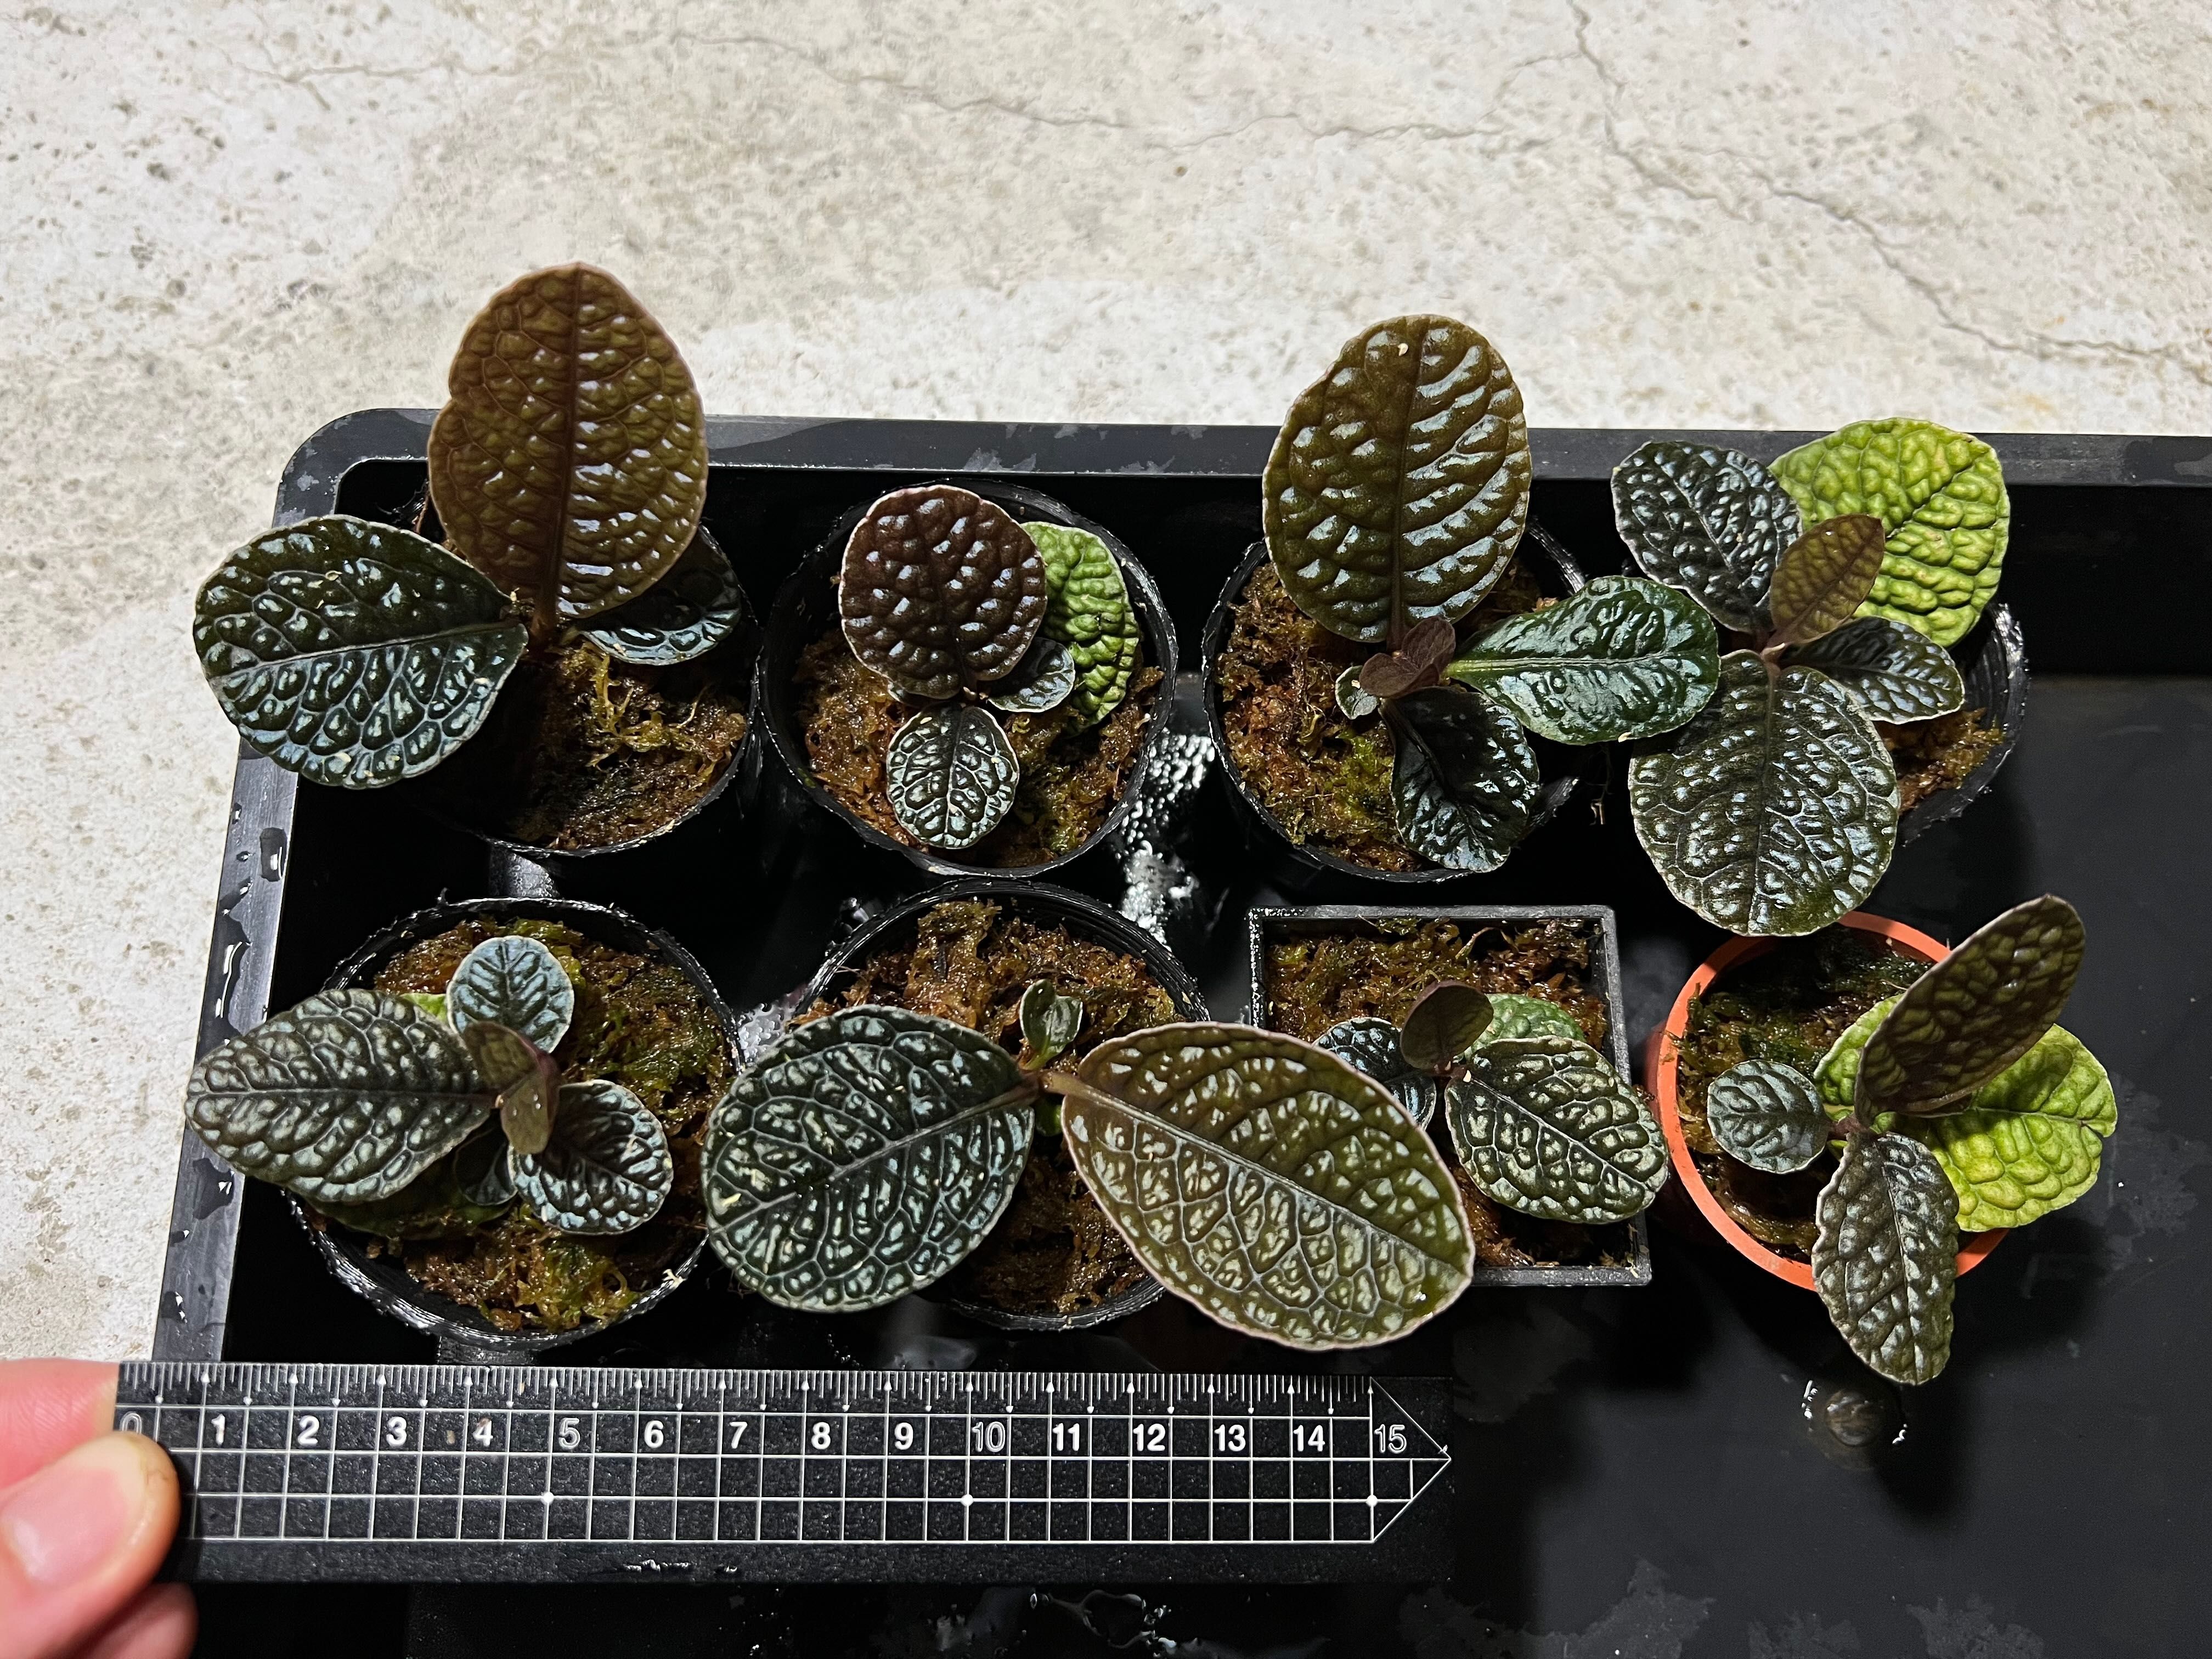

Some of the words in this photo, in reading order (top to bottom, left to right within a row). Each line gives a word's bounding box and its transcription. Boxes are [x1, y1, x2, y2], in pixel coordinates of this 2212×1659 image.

[212, 1414, 225, 1445] 1
[297, 1415, 319, 1446] 2
[386, 1416, 407, 1446] 3
[473, 1418, 494, 1447] 4
[558, 1418, 580, 1449] 5
[644, 1420, 664, 1448] 6
[729, 1421, 748, 1449] 7
[811, 1421, 832, 1451] 8
[894, 1422, 914, 1451] 9
[973, 1421, 1005, 1452] 10
[1052, 1423, 1080, 1452] 11
[1132, 1423, 1166, 1452] 12
[1214, 1424, 1246, 1452] 13
[1293, 1424, 1325, 1452] 14
[1374, 1424, 1407, 1454] 15
